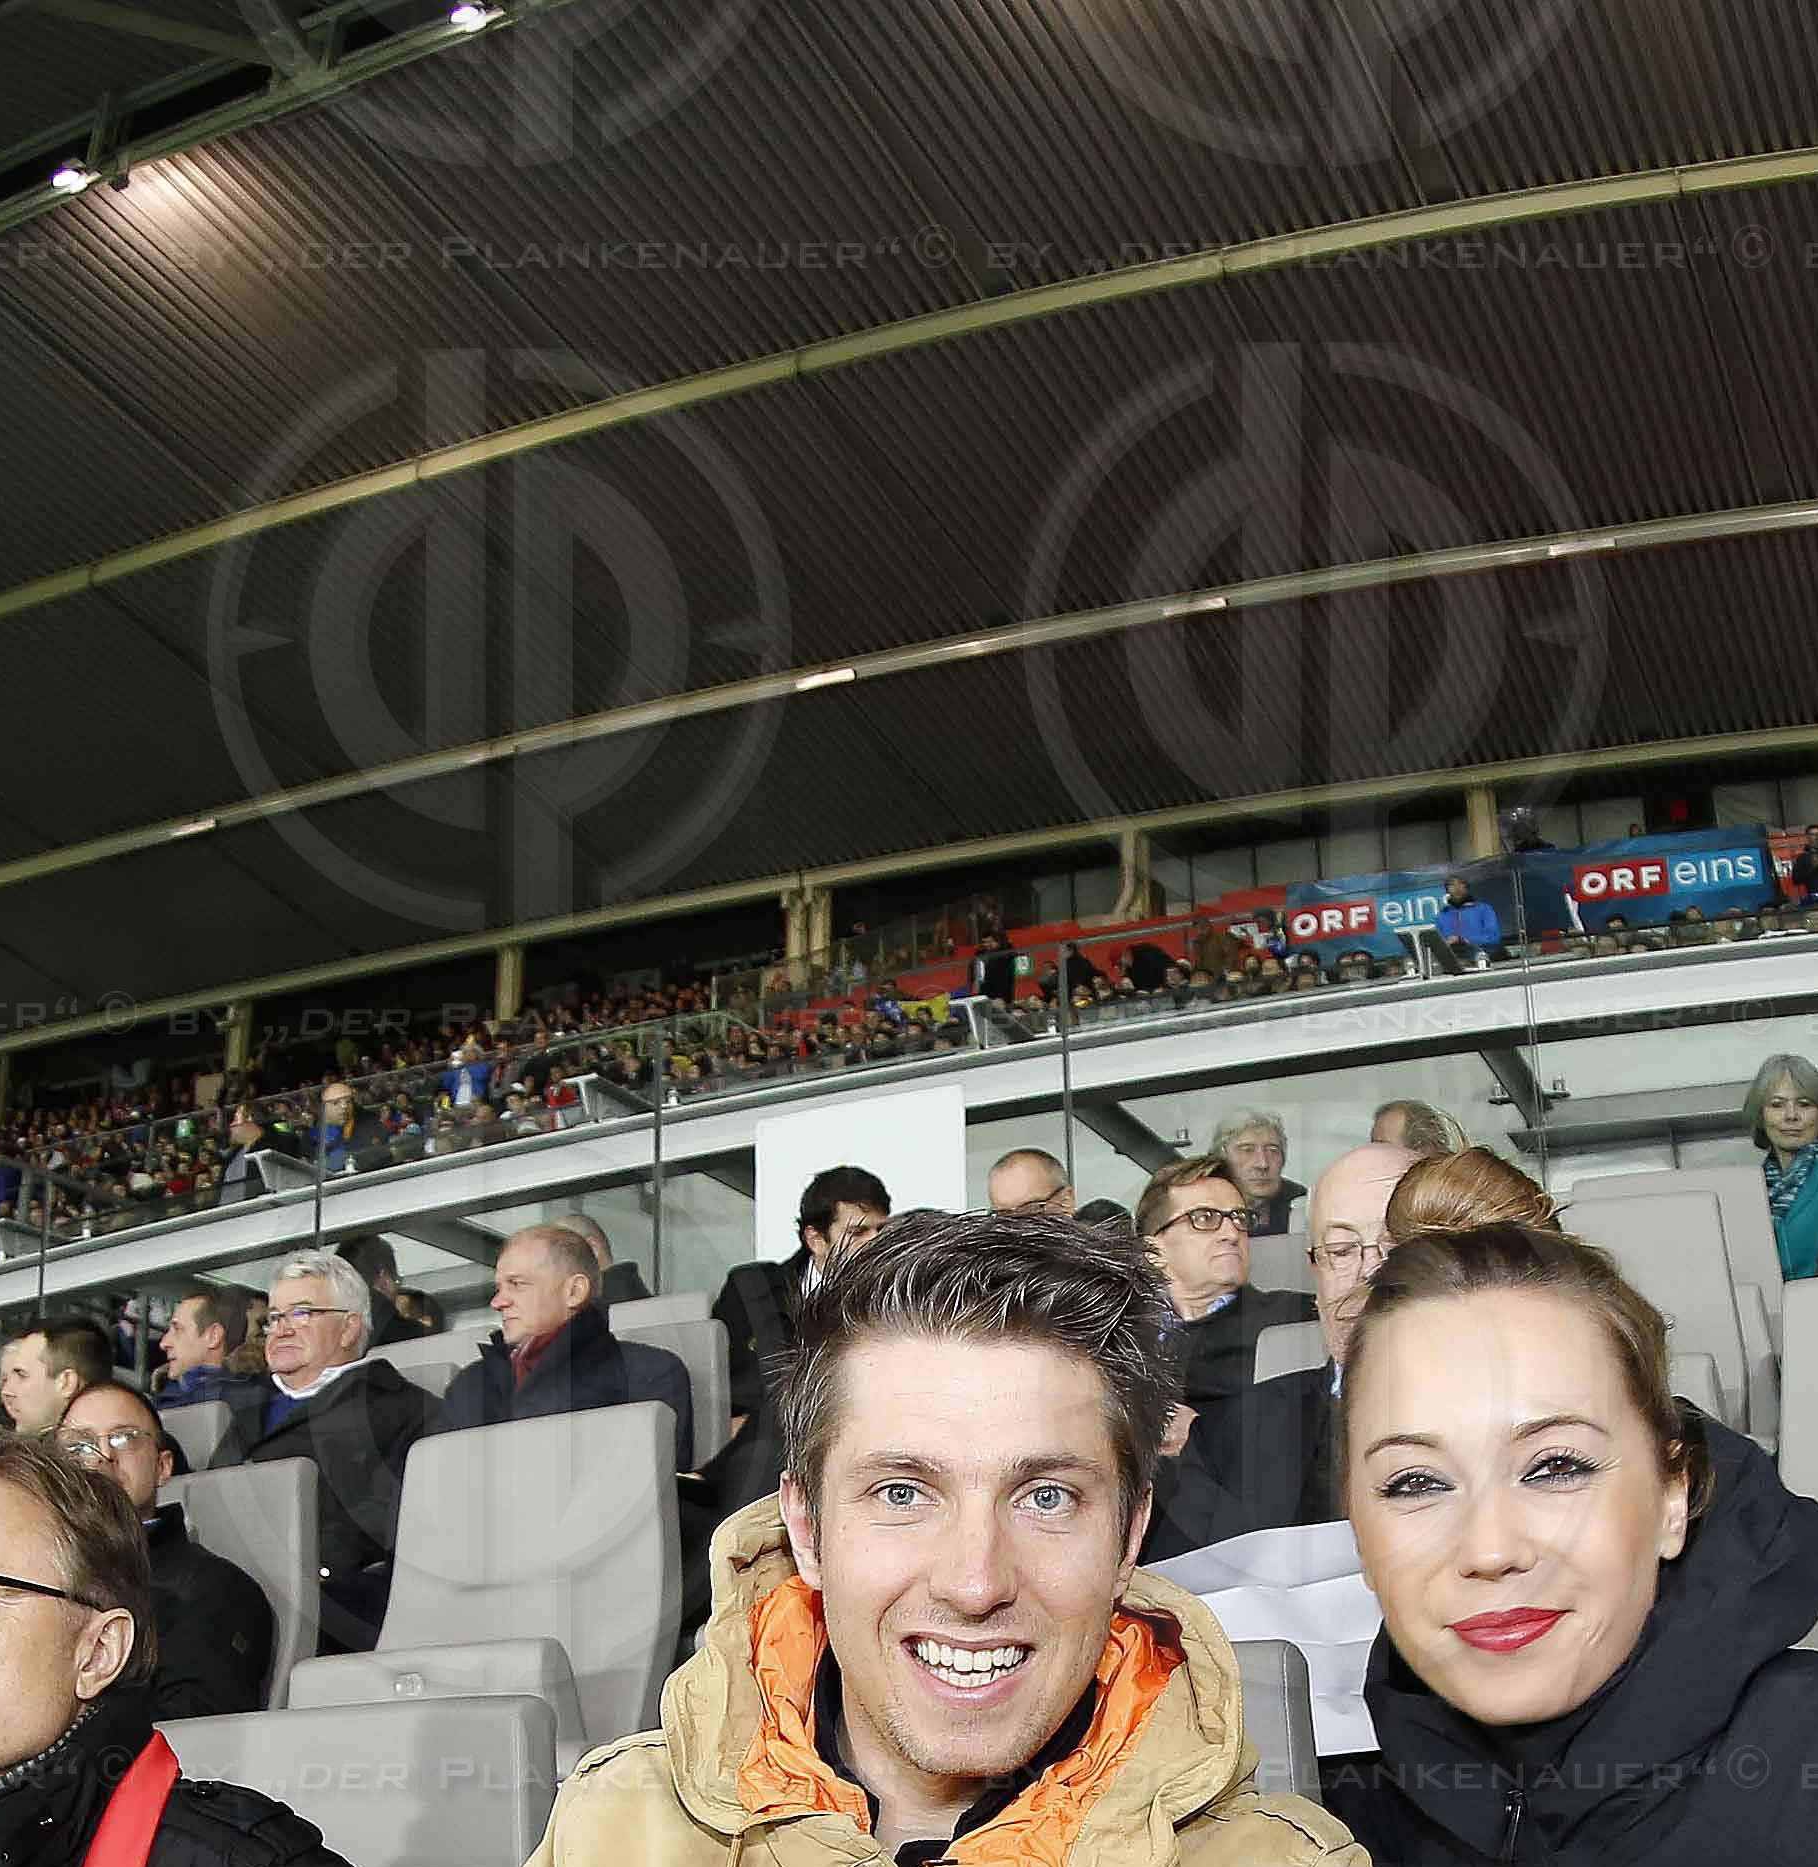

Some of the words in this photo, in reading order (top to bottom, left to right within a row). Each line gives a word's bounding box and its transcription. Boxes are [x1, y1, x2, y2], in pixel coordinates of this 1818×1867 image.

[1581, 865, 1662, 895] ORF
[1674, 854, 1757, 885] eins
[1291, 905, 1371, 938] ORF
[1382, 894, 1451, 924] ein
